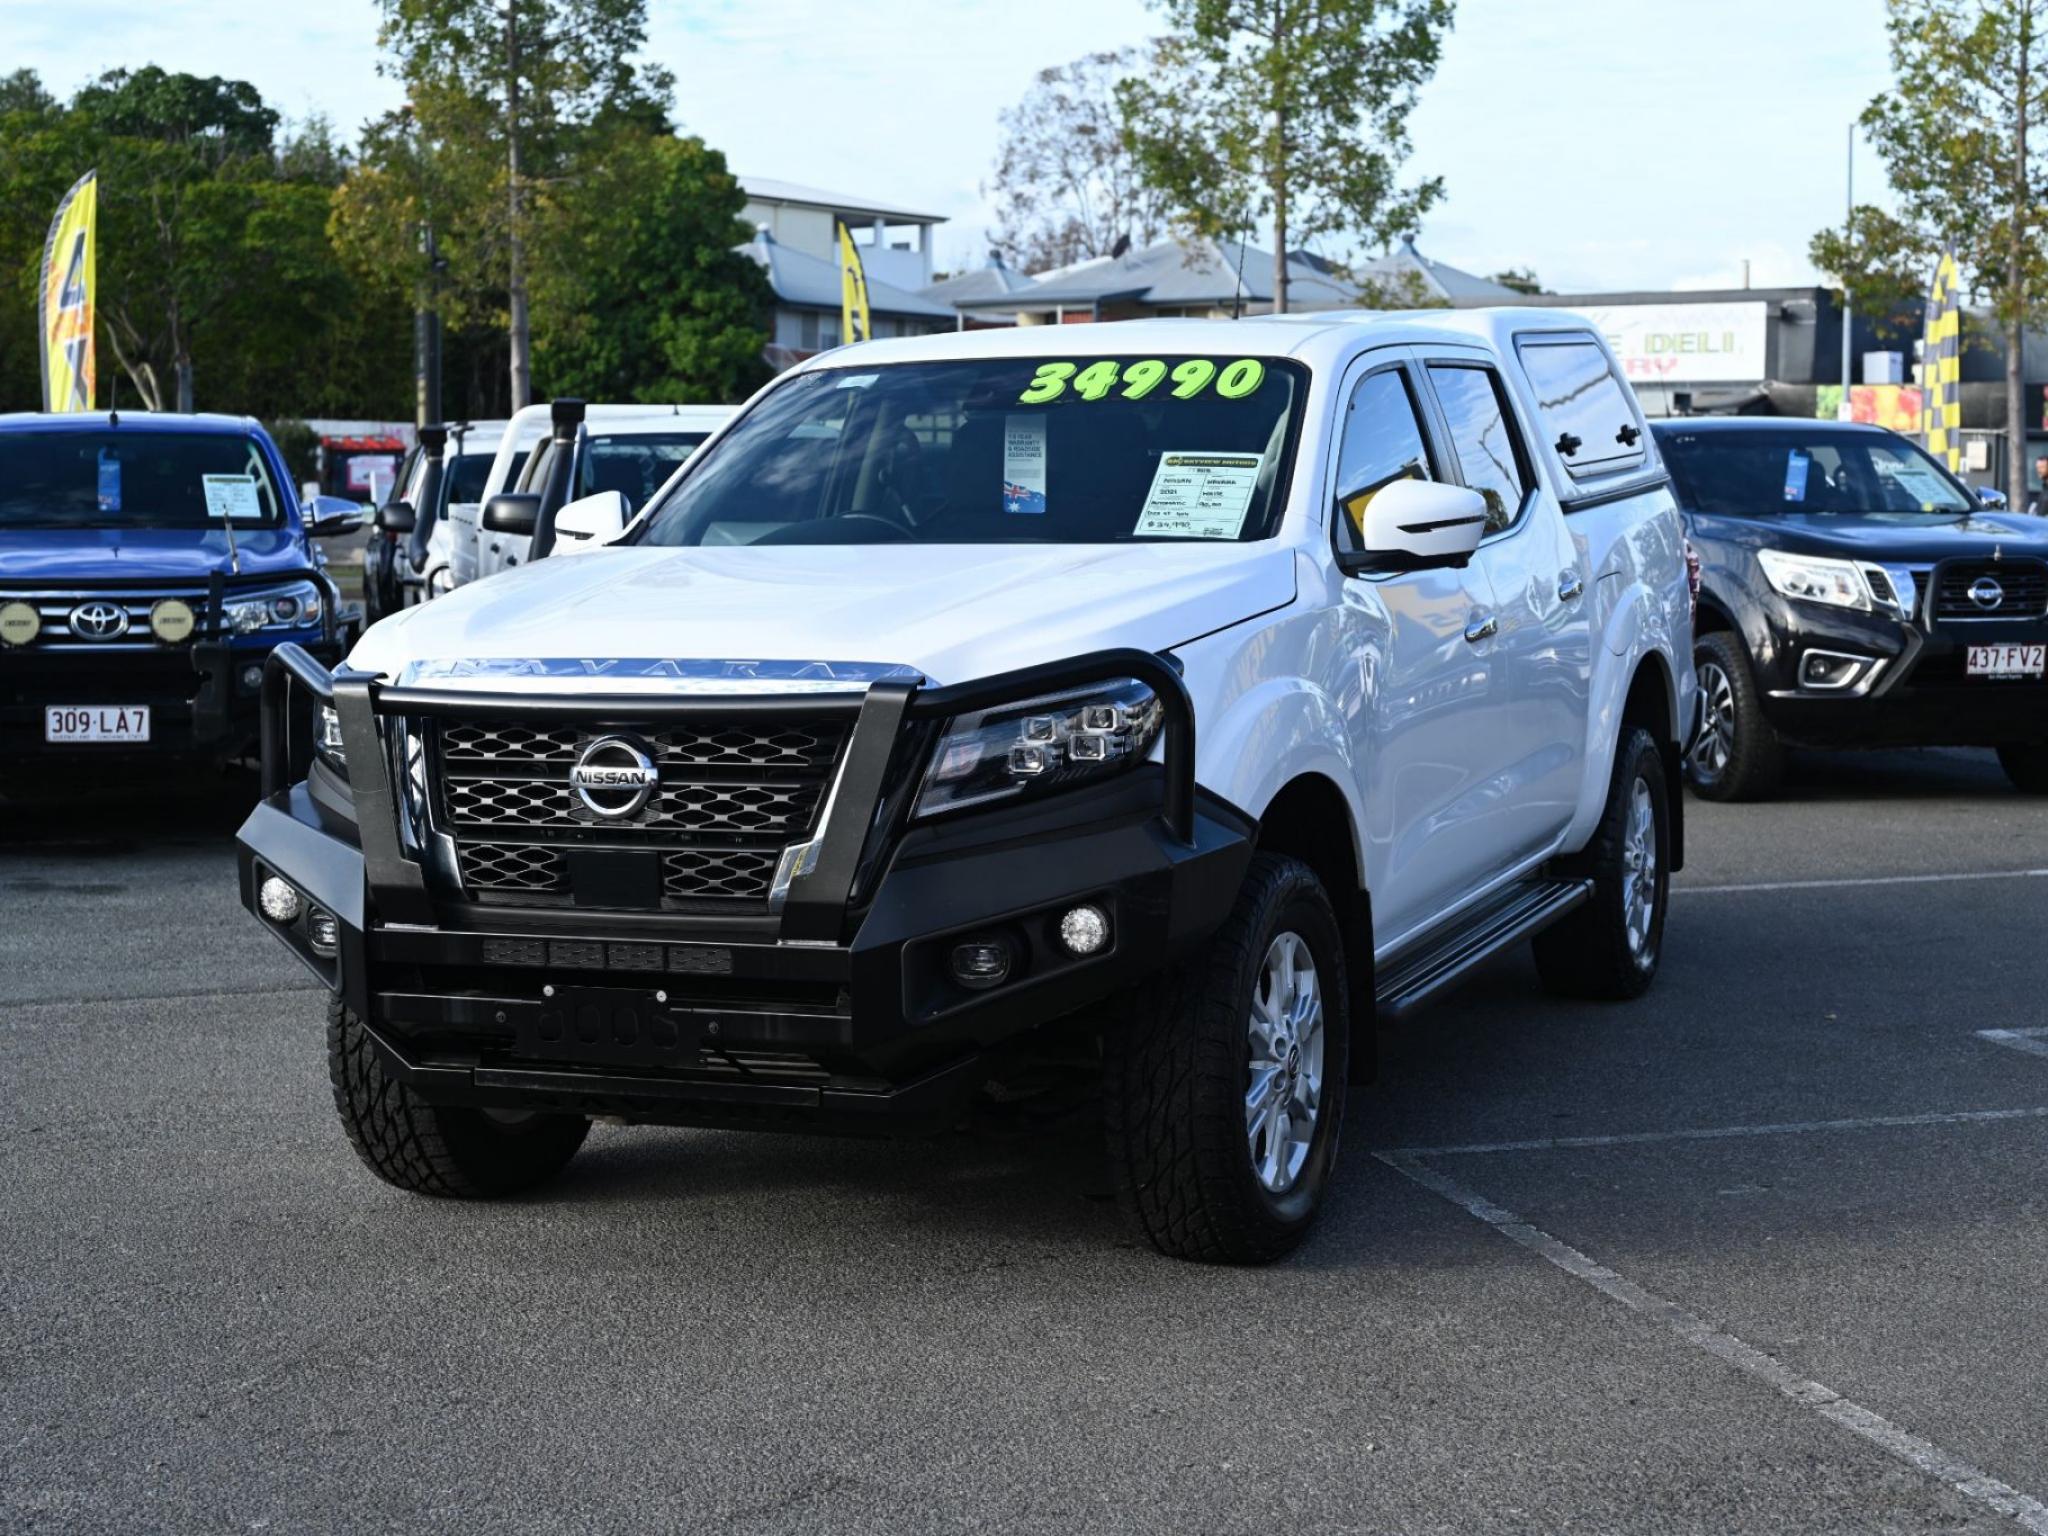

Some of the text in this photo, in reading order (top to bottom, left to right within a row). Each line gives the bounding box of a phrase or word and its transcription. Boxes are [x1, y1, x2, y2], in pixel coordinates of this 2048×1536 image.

[1644, 332, 1735, 355] DELI
[1018, 359, 1266, 404] 34990
[449, 659, 836, 679] NAVARA
[575, 770, 646, 785] NISSAN
